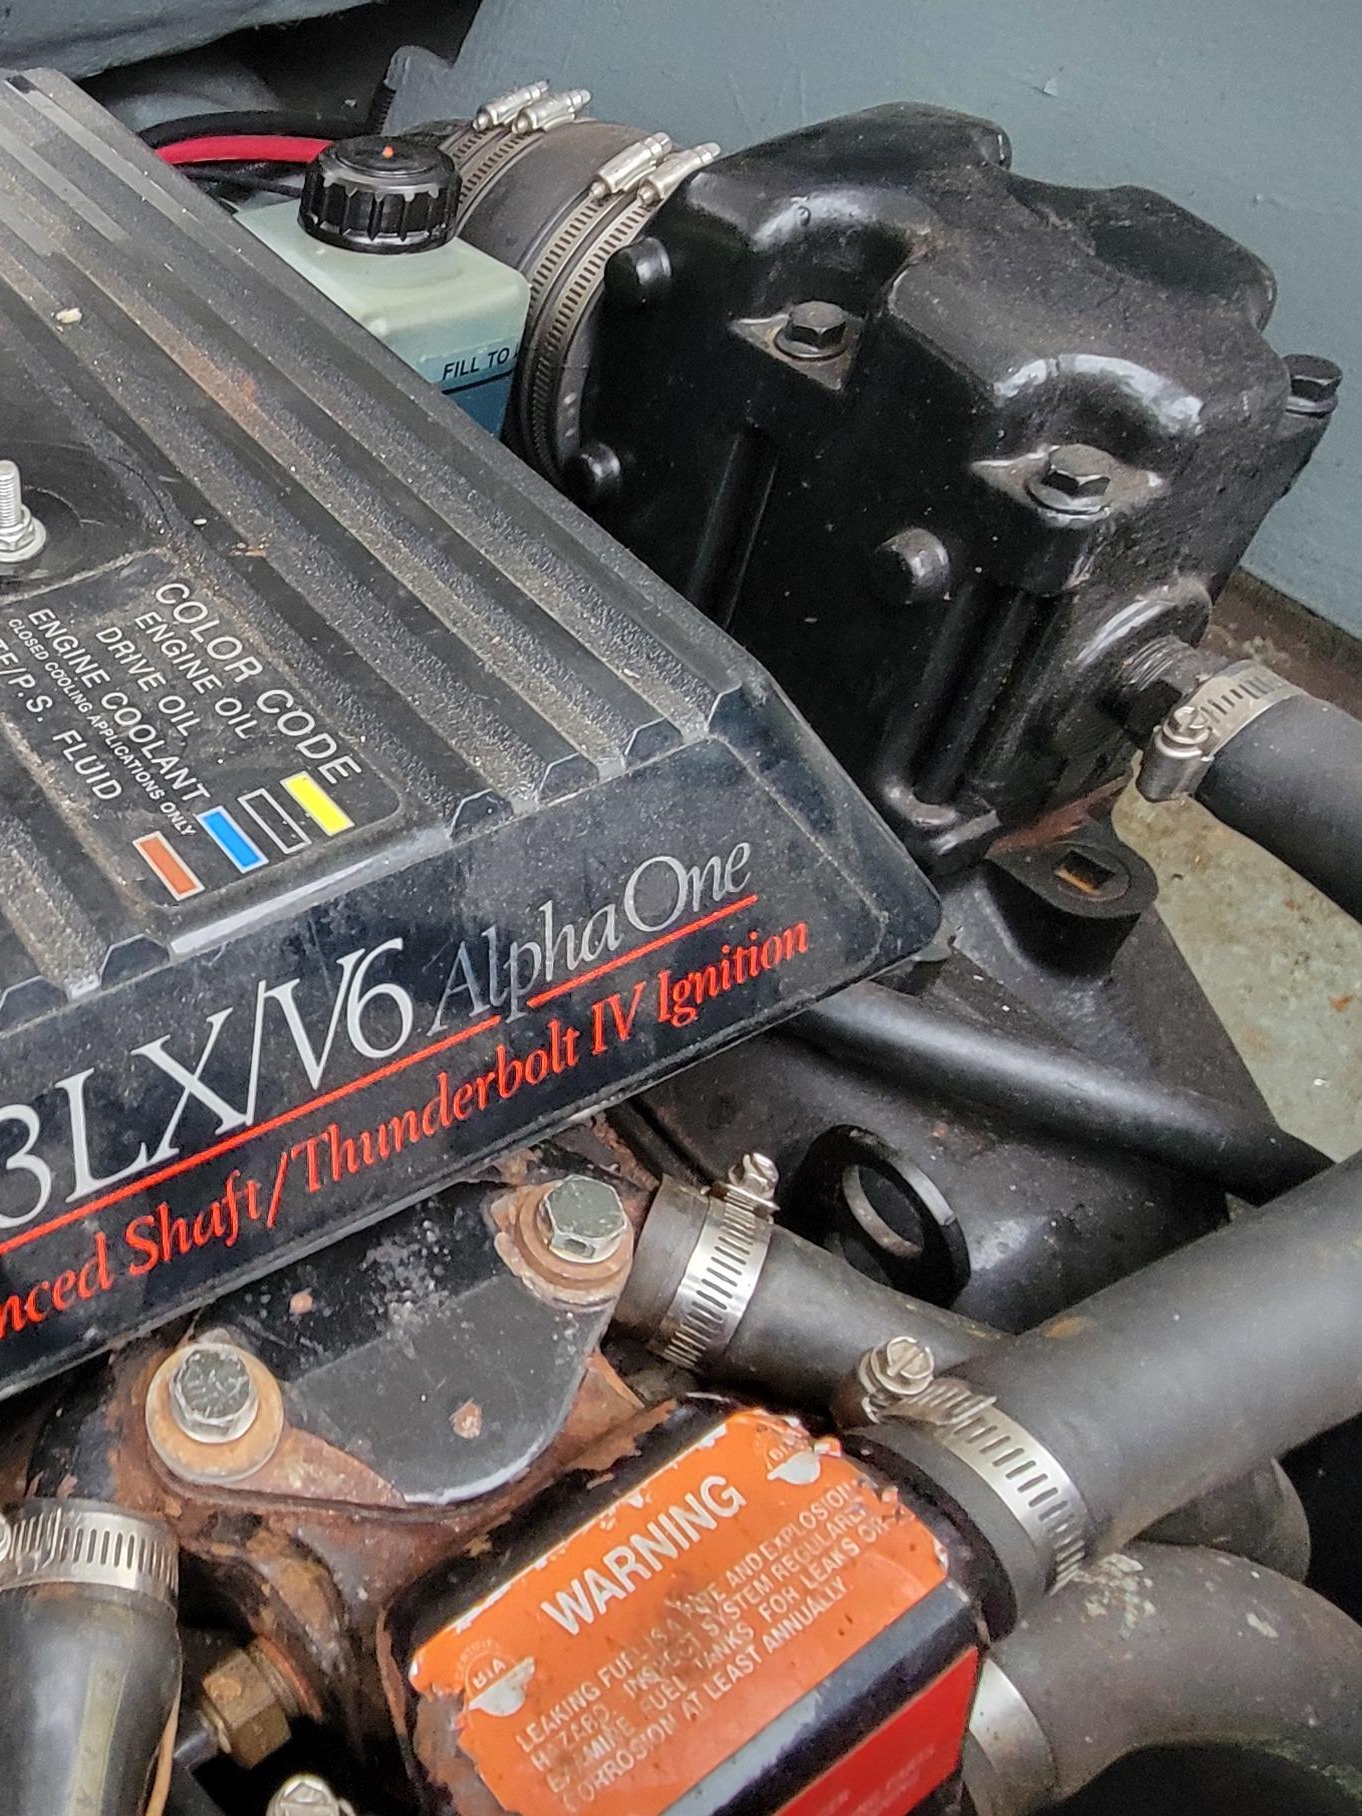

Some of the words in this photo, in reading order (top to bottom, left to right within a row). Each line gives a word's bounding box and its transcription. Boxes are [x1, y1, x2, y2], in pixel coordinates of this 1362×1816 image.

[442, 357, 480, 380] FILL
[487, 347, 510, 368] TO
[8, 618, 50, 661] CLOSED
[44, 661, 93, 714] COOLING
[87, 714, 165, 800] APPLICATIONS
[159, 801, 197, 836] ONLY
[28, 608, 111, 688] ENGINE
[101, 692, 210, 801] COOLANT
[96, 627, 167, 692] DRIVE
[158, 695, 201, 737] OIL
[134, 611, 223, 694] ENGINE
[214, 698, 258, 739] OIL
[156, 583, 263, 682] COLOR
[256, 689, 362, 784] CODE
[52, 729, 123, 800] FLUID
[591, 980, 646, 1057] IV
[656, 920, 809, 1029] Ignition
[540, 1475, 747, 1635] WARNING
[701, 1572, 774, 1637] SYSTEM
[758, 1585, 800, 1623] FOR
[800, 1536, 860, 1590] LEAKS
[516, 1681, 601, 1753] LEAKING
[725, 1552, 763, 1587] AND
[681, 1690, 703, 1721] AT
[703, 1643, 762, 1701] LEAST
